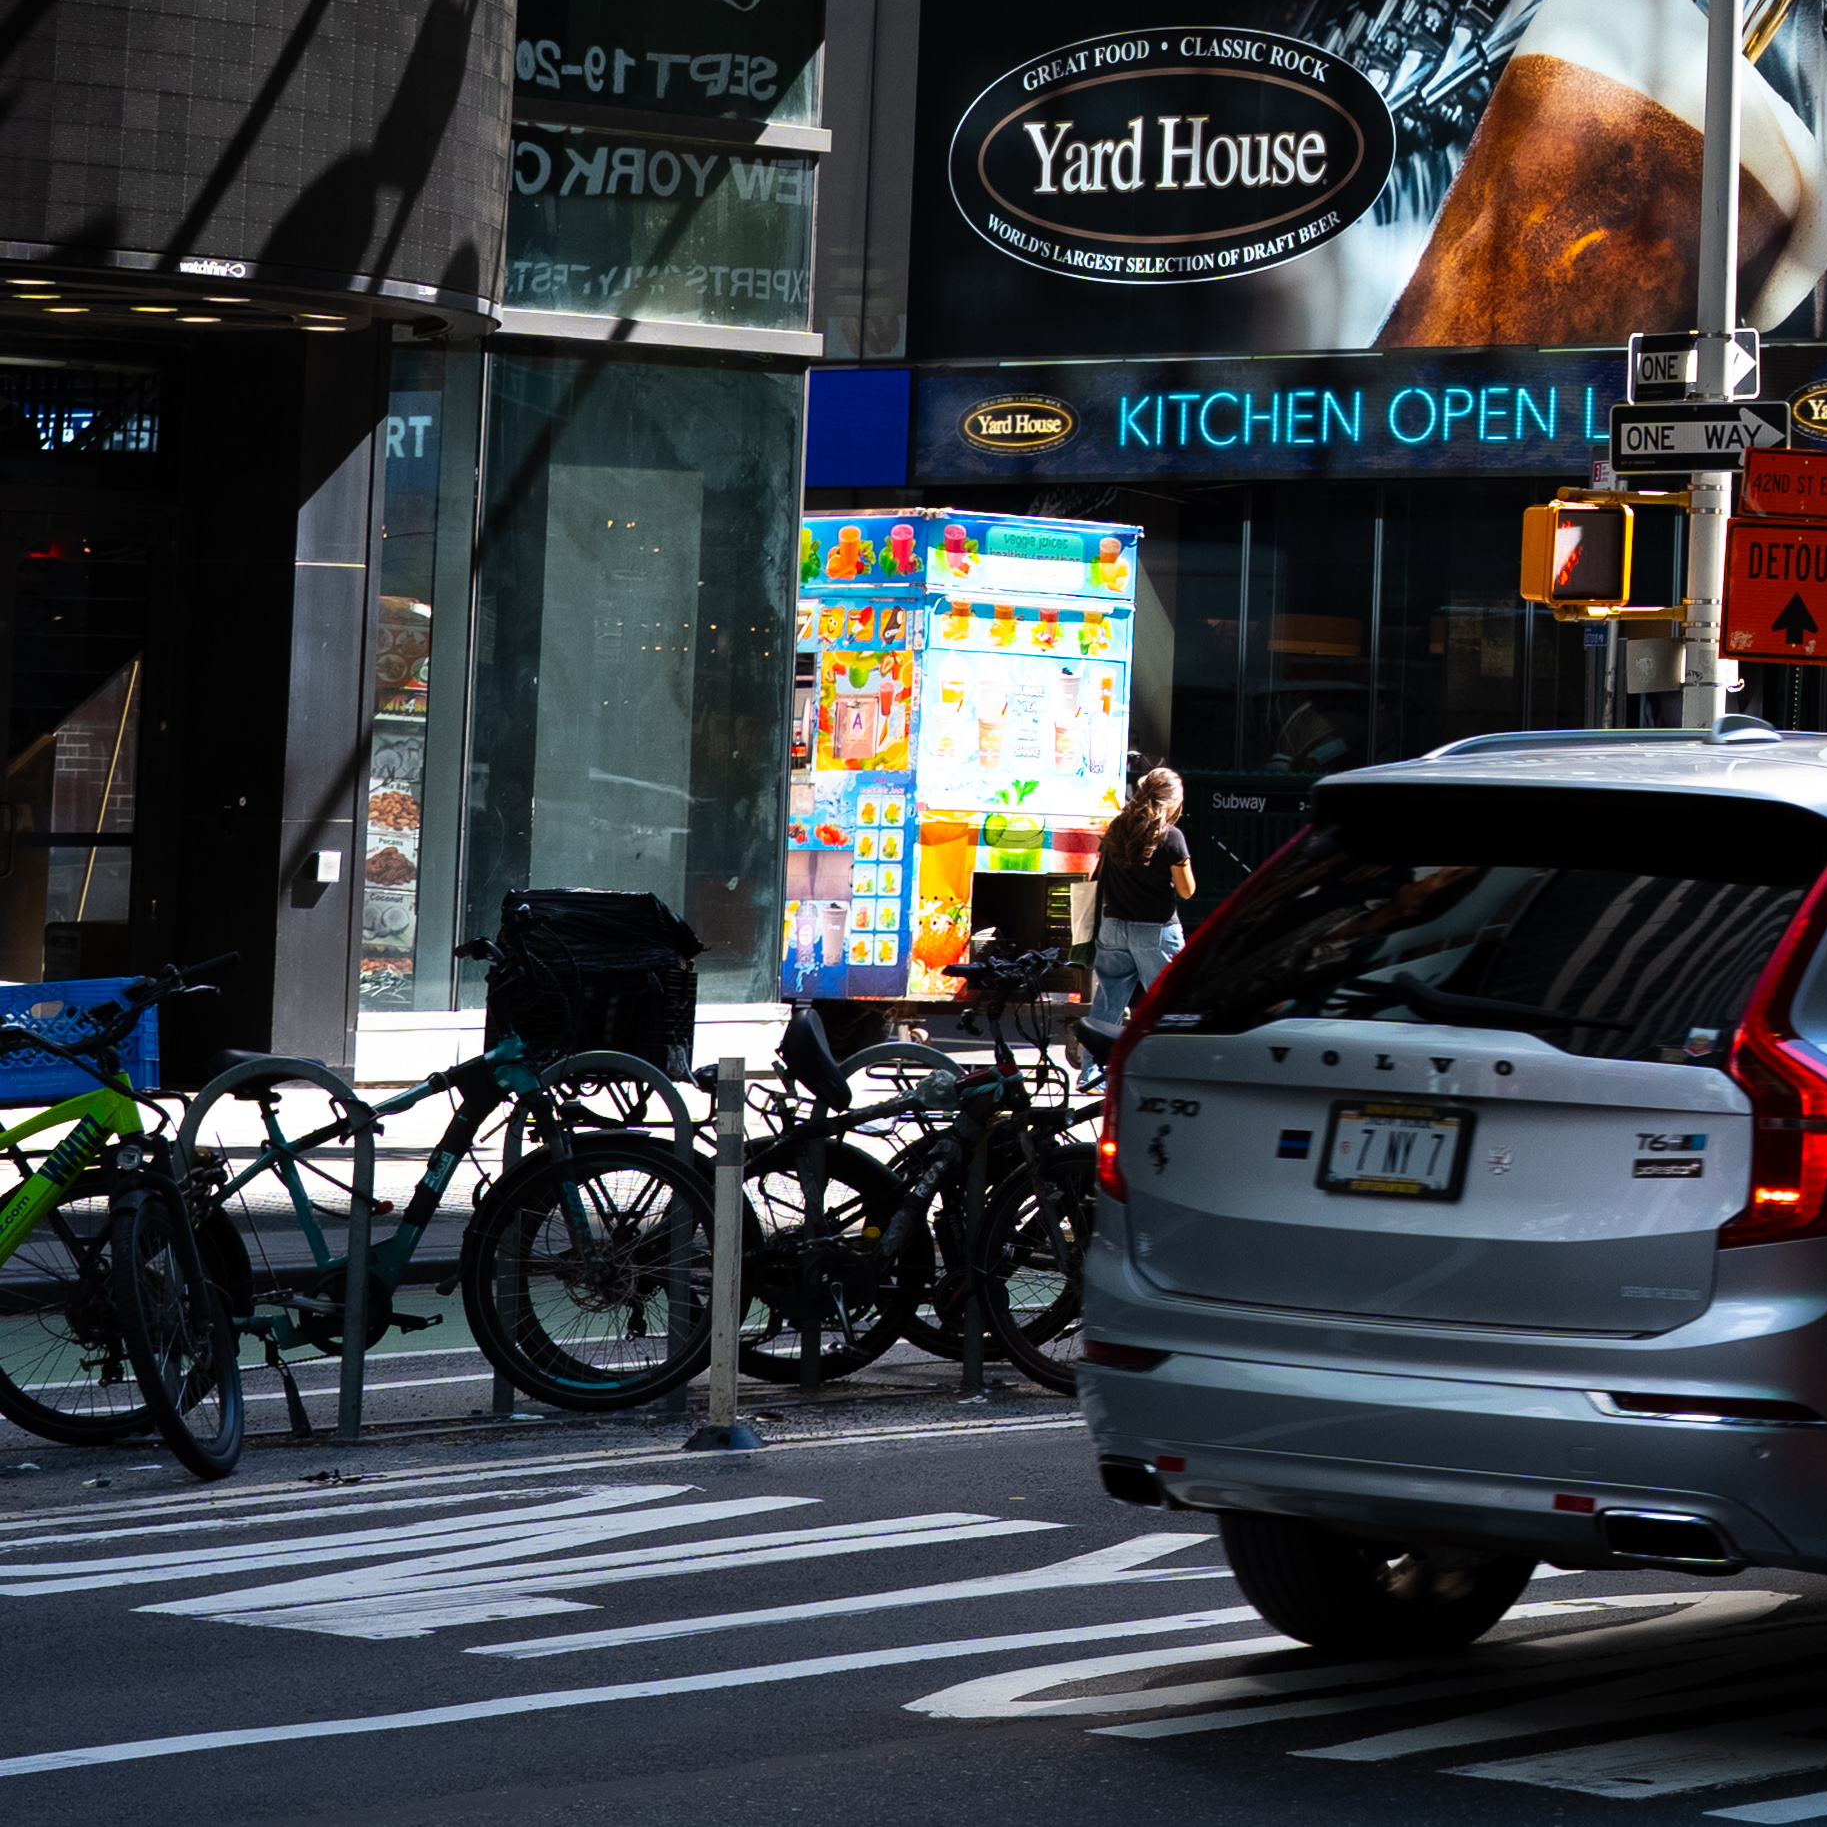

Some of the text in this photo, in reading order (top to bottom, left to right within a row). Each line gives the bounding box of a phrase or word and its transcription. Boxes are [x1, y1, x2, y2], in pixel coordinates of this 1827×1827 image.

[1021, 36, 1330, 92] GREAT FOOD CLASSIC ROCK
[1024, 113, 1328, 195] Yard House
[986, 210, 1342, 274] WORLD'S LARGEST SELECTION OF DRAFT BEER
[1640, 353, 1679, 382] ONE
[977, 412, 1062, 436] Yard House
[1119, 389, 1362, 447] KITCHEN
[1387, 385, 1556, 444] OPEN
[1626, 423, 1764, 451] ONE WAY
[1751, 472, 1791, 495] 42ND
[1795, 476, 1815, 497] ST
[1003, 533, 1069, 551] veggie juices
[852, 712, 863, 730] A
[369, 892, 404, 905] Coconut
[1268, 1045, 1517, 1078] VOLVO
[1356, 1129, 1449, 1176] 7 NY 7
[1636, 1133, 1668, 1152] T6
